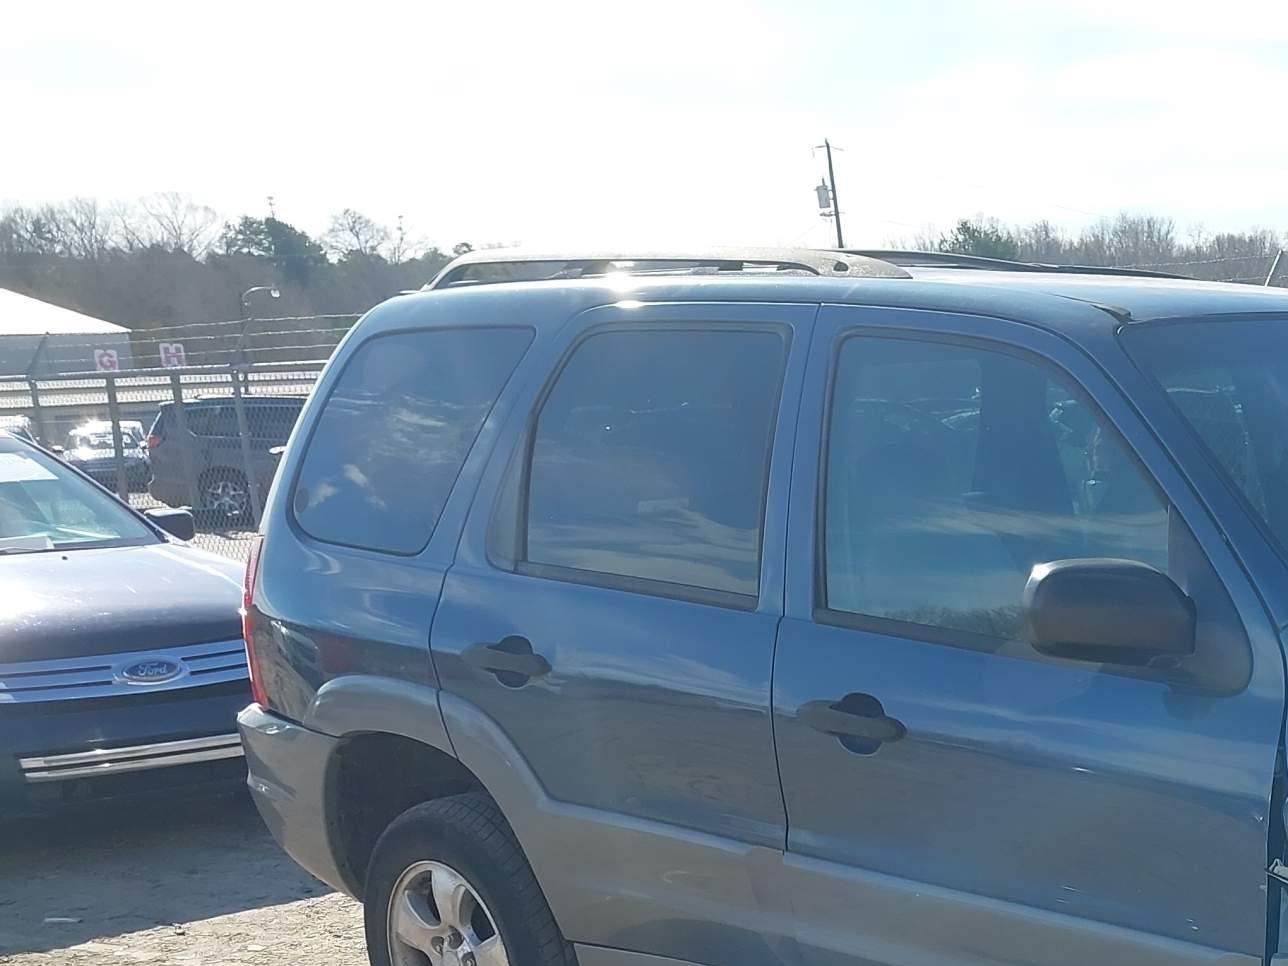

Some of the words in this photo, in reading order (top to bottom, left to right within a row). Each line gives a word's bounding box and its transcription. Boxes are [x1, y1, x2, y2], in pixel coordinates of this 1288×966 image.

[98, 352, 117, 369] G
[163, 346, 184, 367] H
[137, 660, 168, 676] Ford
